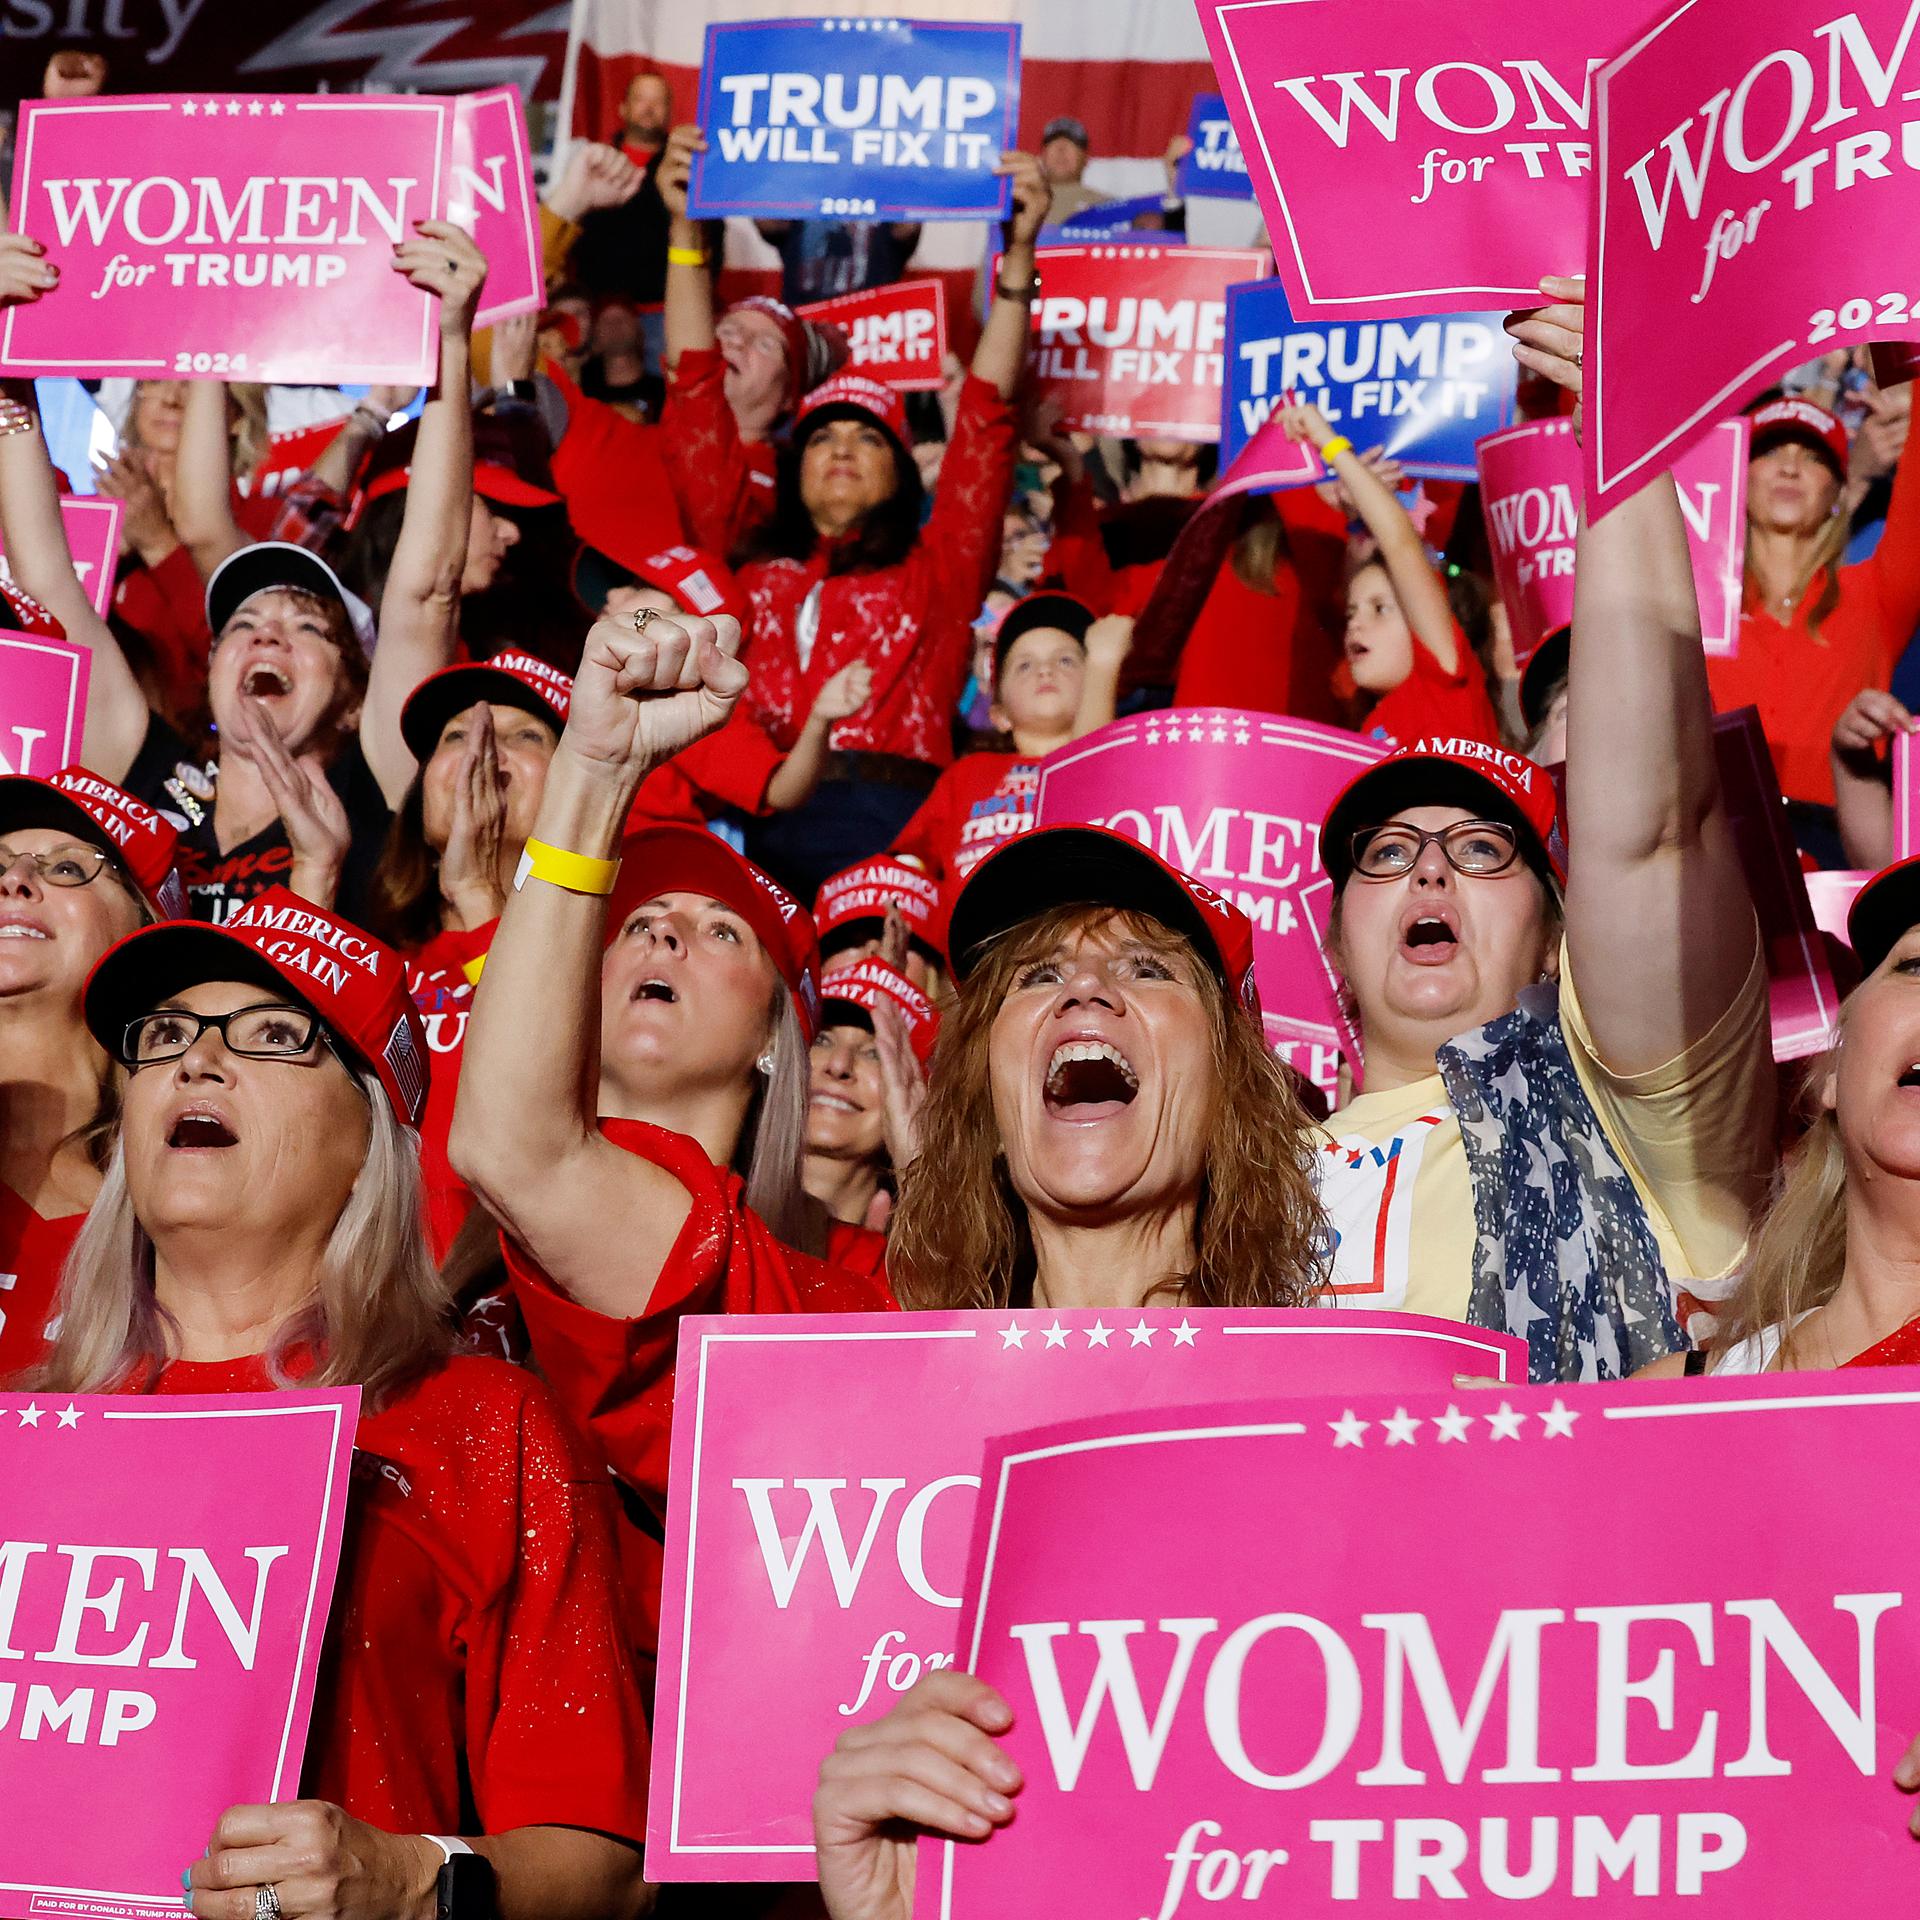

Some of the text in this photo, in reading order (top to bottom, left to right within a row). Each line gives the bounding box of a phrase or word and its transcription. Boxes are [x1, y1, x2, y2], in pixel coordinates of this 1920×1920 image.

[720, 73, 998, 131] TRUMP
[1274, 58, 1607, 148] WOM
[718, 128, 991, 169] WILL FIX IT
[1411, 148, 1495, 204] for
[42, 176, 418, 247] WOMEN
[91, 253, 347, 299] for TRUMP
[1691, 200, 1772, 304] for
[846, 308, 935, 350] UMP
[1031, 296, 1226, 351] RUMP
[174, 351, 247, 374] 2024
[1028, 347, 1099, 380] ILL
[1109, 348, 1182, 385] FIX
[1239, 322, 1494, 397] TRUMP
[1351, 379, 1429, 419] FIX
[1439, 380, 1489, 420] IT
[1489, 483, 1580, 556] WOM
[491, 653, 575, 692] AMERIC
[1087, 804, 1322, 890] OME
[230, 904, 380, 977] AMERICA
[1010, 1591, 1903, 1792] WOMEN
[1138, 1811, 1748, 1920] for TRUMP
[36, 1899, 58, 1908] PAID
[58, 1901, 76, 1910] FOR
[77, 1903, 90, 1911] BY
[90, 1904, 125, 1915] DONALD
[135, 1909, 165, 1919] TRUMP
[165, 1911, 182, 1920] FOR
